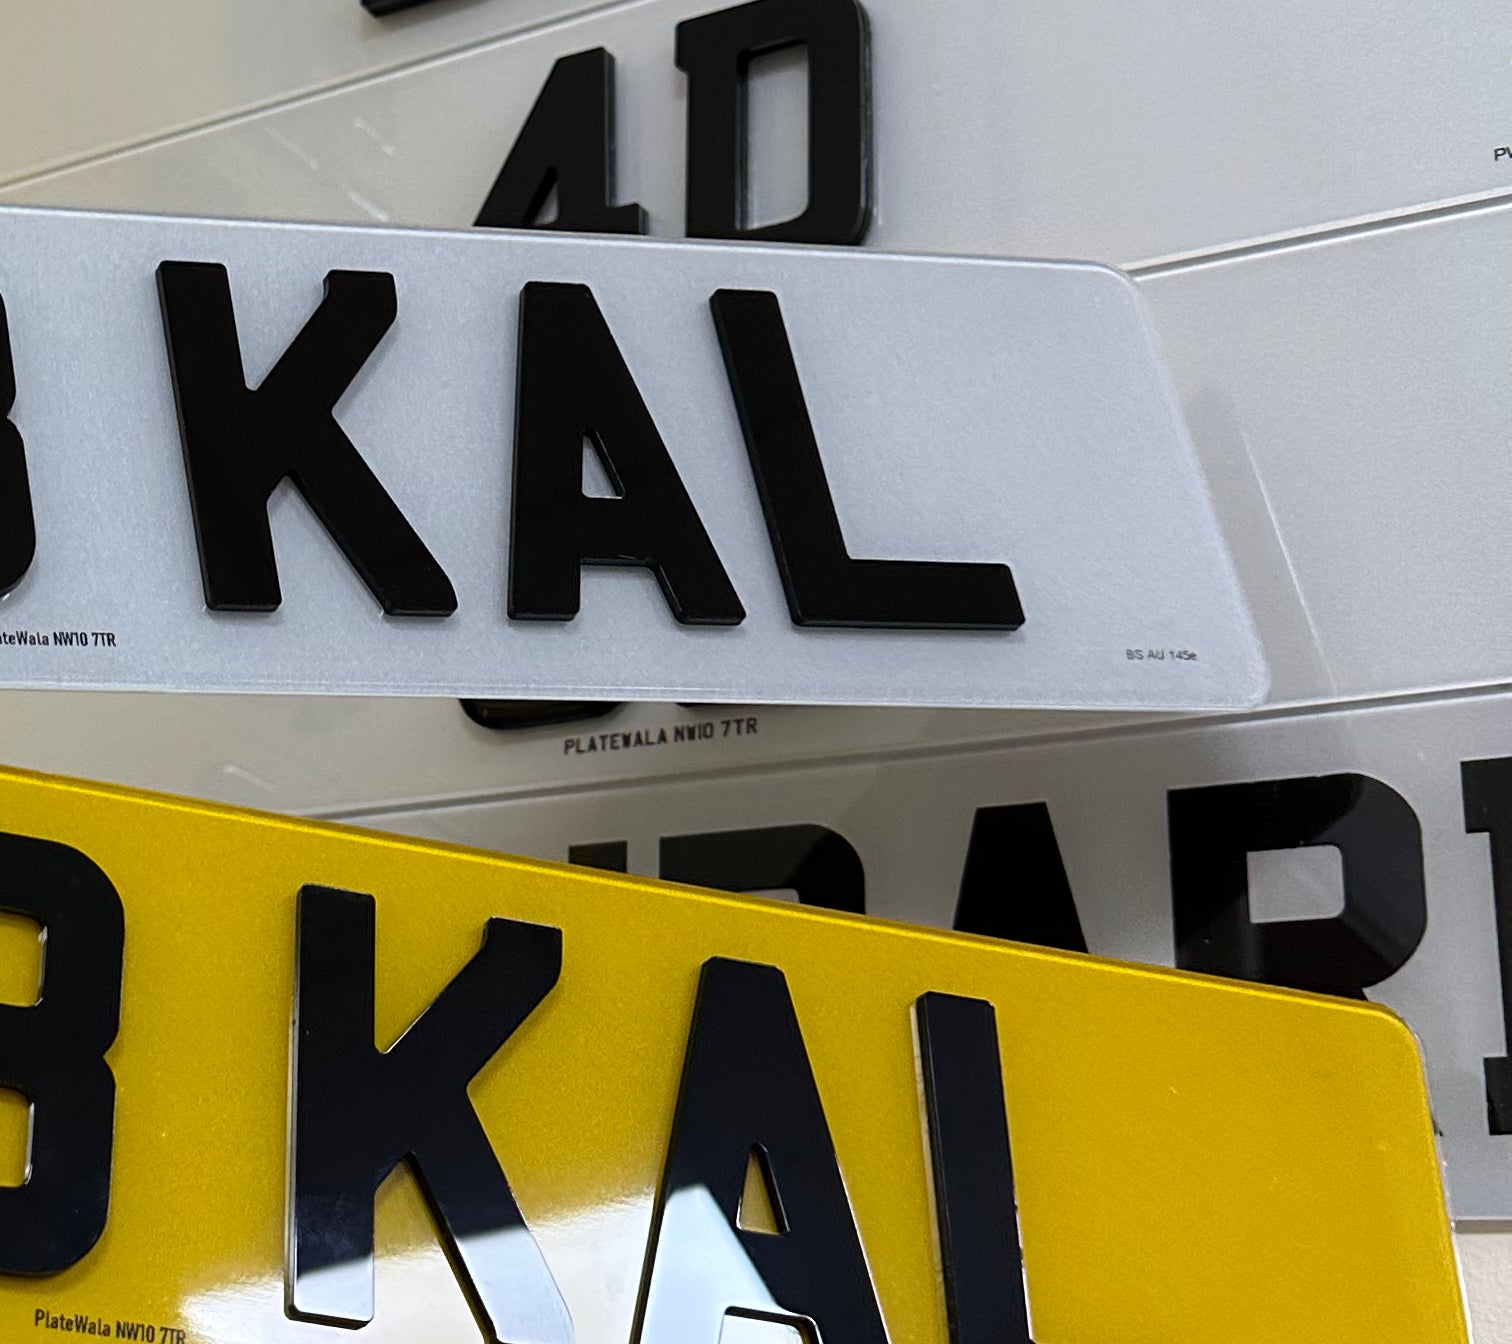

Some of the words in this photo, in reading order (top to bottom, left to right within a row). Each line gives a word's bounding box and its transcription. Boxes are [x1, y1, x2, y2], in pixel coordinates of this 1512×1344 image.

[155, 260, 1026, 631] KAL
[52, 631, 88, 647] NW10
[91, 632, 117, 648] 7TR
[1125, 648, 1144, 660] BS
[1147, 649, 1165, 661] AU
[563, 728, 668, 755] PLATEWALA
[673, 721, 714, 743] NW10
[720, 717, 758, 737] 7TR
[33, 1307, 111, 1337] PlateWala
[115, 1320, 156, 1343] NW10
